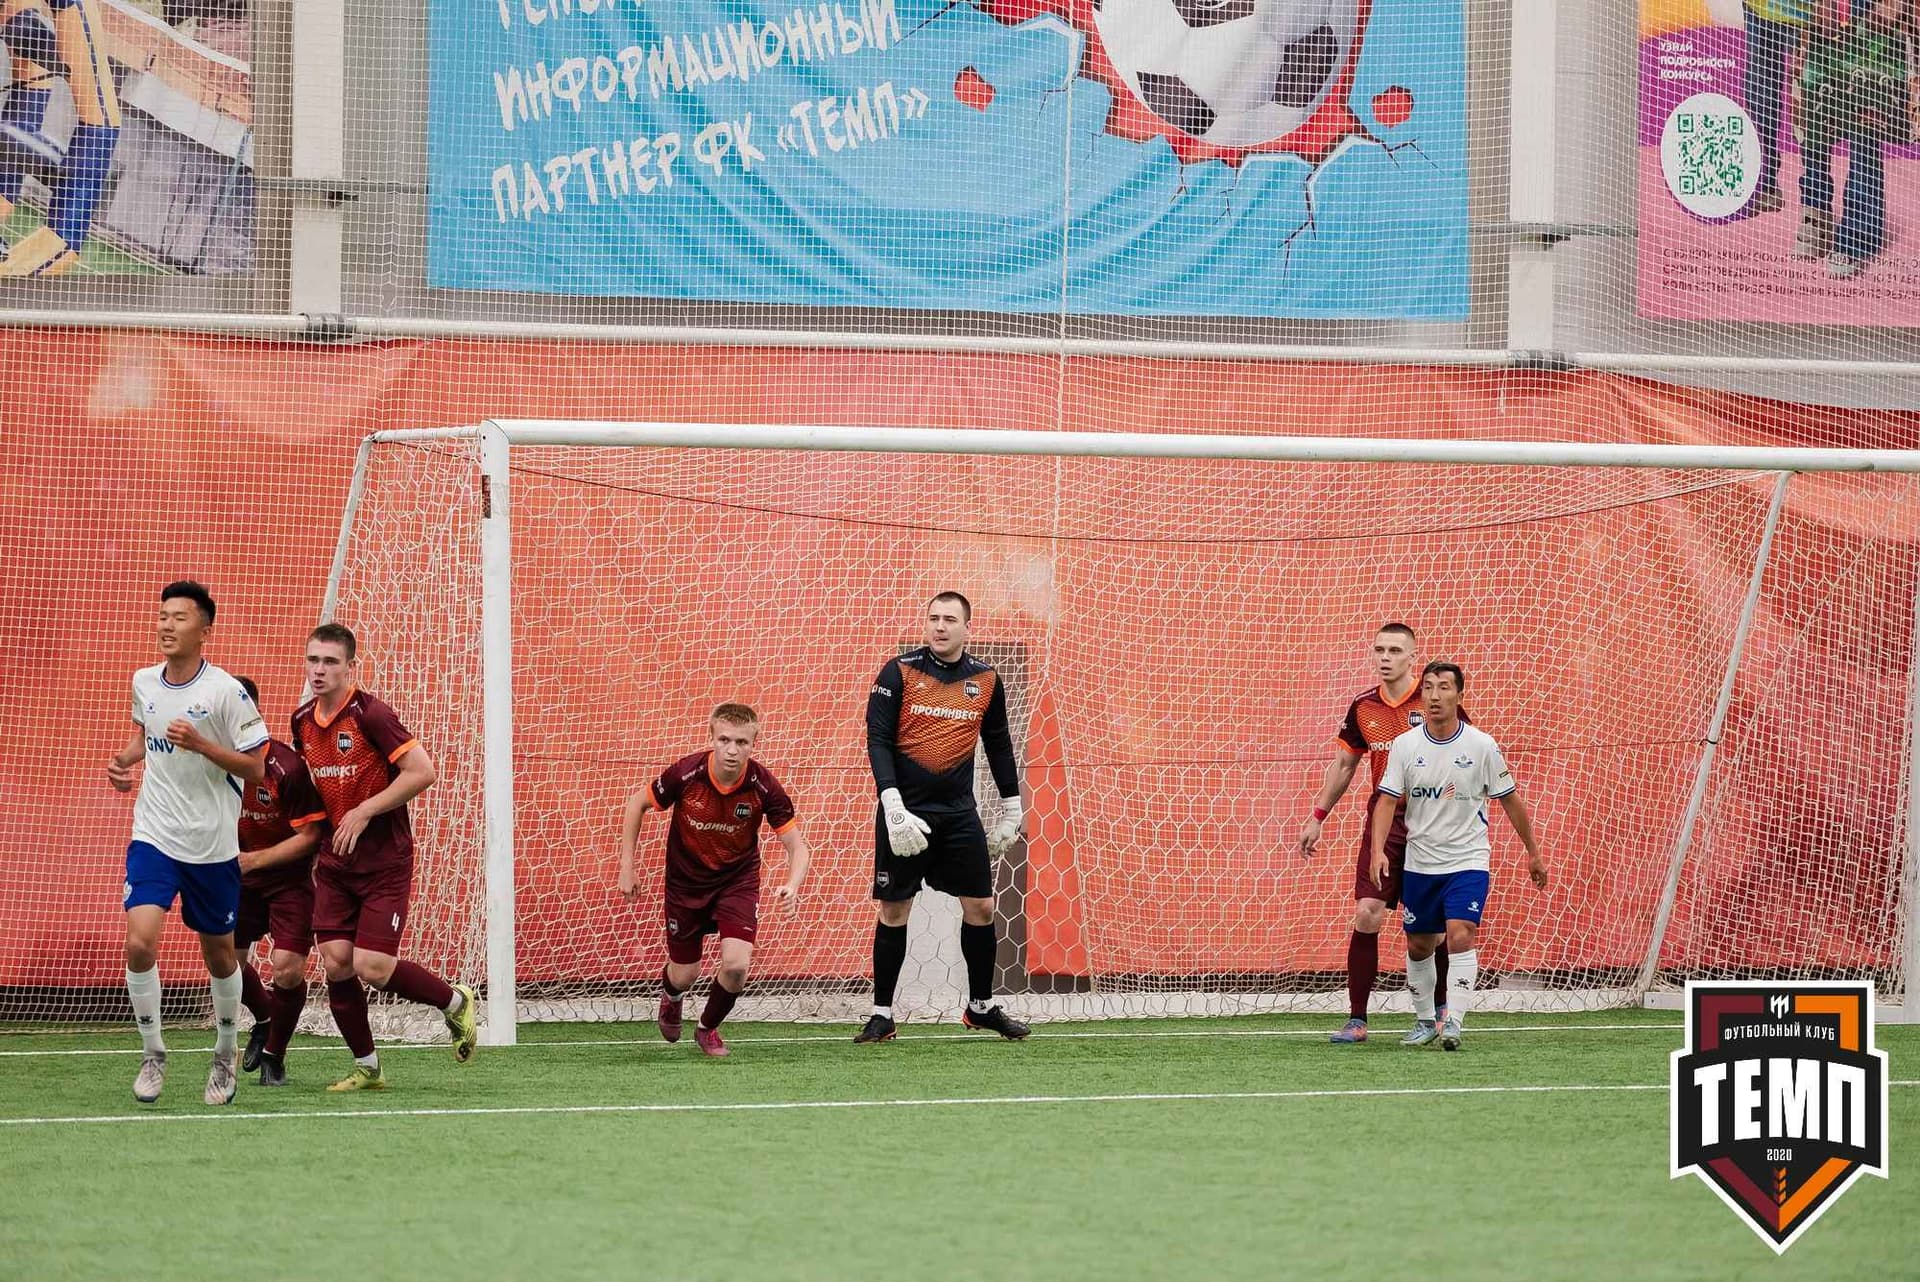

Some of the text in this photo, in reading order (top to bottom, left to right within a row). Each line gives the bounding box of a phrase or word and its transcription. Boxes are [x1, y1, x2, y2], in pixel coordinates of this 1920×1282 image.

[494, 0, 901, 131] ИНФОРМАЦИОННЫЙ
[1660, 55, 1735, 68] ПОДРОБНОСТИ
[1660, 69, 1713, 81] КОНКУРСА
[491, 81, 929, 224] ПАРТНЕР ФК «ТЕМП»
[910, 704, 978, 720] ПРОДИНВЕСТ
[146, 736, 175, 753] GNV
[1411, 786, 1444, 800] GNV
[391, 912, 400, 932] 4
